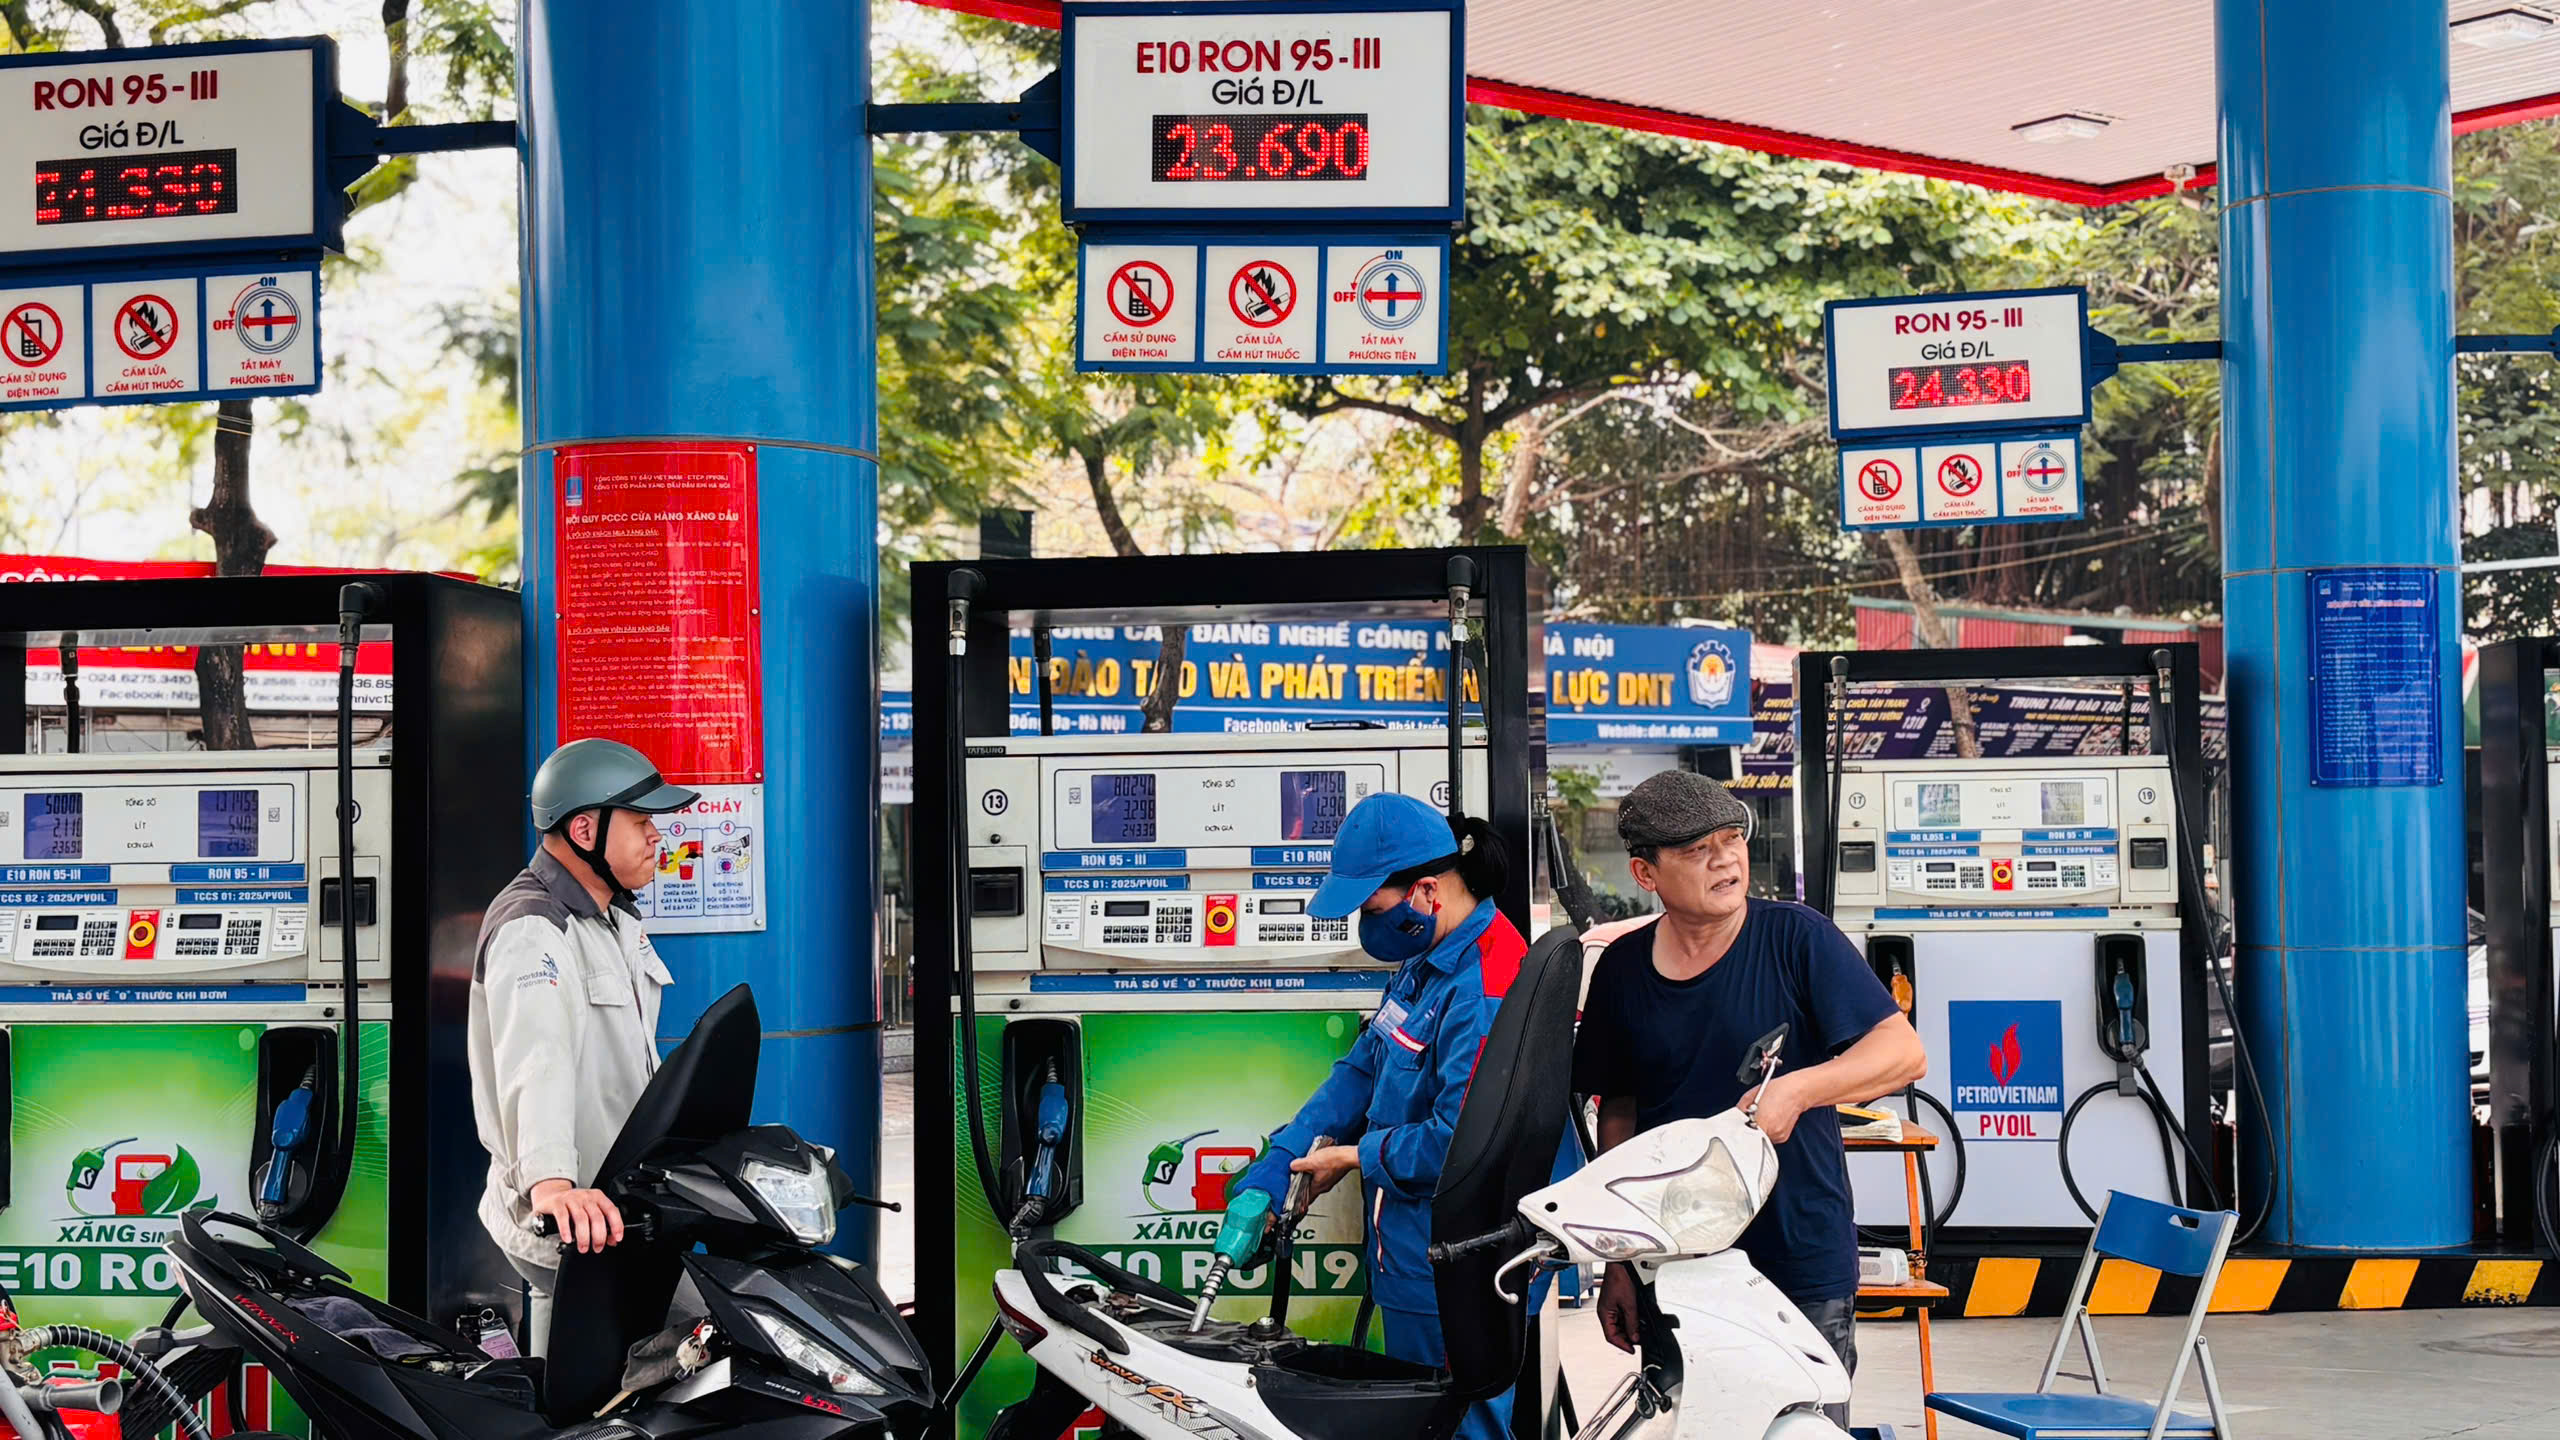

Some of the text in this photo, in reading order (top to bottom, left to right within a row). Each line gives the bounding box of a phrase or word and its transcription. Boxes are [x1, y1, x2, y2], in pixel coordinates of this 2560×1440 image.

[1136, 42, 1190, 73] E10
[1199, 39, 1281, 72] RON
[34, 77, 114, 111] RON
[1212, 76, 1323, 107] Giá Đ/L
[79, 119, 184, 150] Giá Đ/L
[1166, 121, 1369, 179] 23.690
[1385, 250, 1403, 260] ON
[260, 277, 277, 286] ON
[1333, 291, 1356, 302] OFF
[213, 319, 235, 331] OFF
[1895, 312, 1950, 335] RON
[1103, 332, 1128, 344] CẤM
[1145, 334, 1176, 345] DỤNG
[1236, 333, 1261, 345] CẤM
[1361, 334, 1404, 345] TẮT MÁY
[1112, 348, 1136, 359] ĐIỆN
[1217, 347, 1243, 360] CẤM
[1266, 347, 1300, 360] THUỐC
[1349, 349, 1417, 361] PHƯƠNG TIỆN
[1921, 341, 1994, 360] Giá Đ/L
[240, 358, 282, 370] TẮT MÁY
[122, 364, 146, 377] CẤM
[38, 371, 67, 383] DỤNG
[229, 373, 295, 385] PHƯƠNG TIỆN
[106, 380, 129, 392] CẤM
[152, 378, 184, 390] THUỐC
[1895, 364, 2030, 409] 24.330
[7, 386, 30, 398] ĐIỆN
[2006, 470, 2021, 479] OFF
[582, 514, 600, 524] QUY
[601, 513, 628, 522] PCCC
[630, 511, 650, 521] CỬA
[654, 511, 683, 521] HÀNG
[687, 510, 715, 521] XĂNG
[718, 509, 739, 521] DẦU
[1357, 624, 1429, 650] CÔNG
[1573, 633, 1614, 661] NỘI
[1208, 653, 1252, 699] VÀ
[1260, 654, 1347, 700] PHÁT
[1355, 652, 1446, 702] TRIỂN
[1552, 667, 1610, 712] LỰC
[1617, 672, 1675, 706] DNT
[2009, 696, 2049, 710] TRUNG
[2049, 697, 2076, 710] TÂM
[2075, 698, 2101, 712] ĐÀO
[1224, 717, 1293, 733] Facebook:
[1902, 715, 1928, 730] 1310
[987, 794, 1003, 808] 13
[1852, 796, 1863, 805] 17
[2142, 791, 2153, 800] 19
[674, 823, 681, 835] 3
[724, 823, 730, 833] 4
[1081, 854, 1105, 866] RON
[1109, 855, 1122, 865] 95
[1283, 850, 1331, 862] E10 RON
[7, 869, 26, 881] E10
[29, 869, 51, 880] RON
[208, 868, 231, 880] RON
[234, 868, 248, 879] 95
[1063, 879, 1089, 889] TCCS
[1111, 878, 1168, 888] 2025/PVOIL
[1264, 876, 1311, 886] TCCS 02
[0, 893, 107, 903] CCS 02 2025/PVOIL
[194, 891, 218, 901] TCCS
[238, 891, 292, 900] 2025/PVOIL
[1114, 978, 1138, 989] TRẢ
[1142, 977, 1159, 989] SỐ
[1163, 977, 1178, 988] VỀ
[1205, 976, 1246, 988] TRƯỚC
[1250, 978, 1271, 987] KHI
[1275, 977, 1305, 987] BƠM
[51, 990, 73, 1001] TRẢ
[76, 989, 93, 1000] SỐ
[96, 989, 110, 1000] VỀ
[135, 990, 173, 1000] TRƯỚC
[177, 991, 196, 1000] KHI
[200, 991, 227, 1000] BƠM
[1957, 1085, 2058, 1105] PETROVIETNAM
[1980, 1114, 2037, 1137] PVOIL
[57, 1221, 167, 1243] XĂNG SIN
[1133, 1217, 1219, 1239] XĂNG
[0, 1252, 178, 1291] E10 RO
[1091, 1353, 1148, 1385] WAVE
